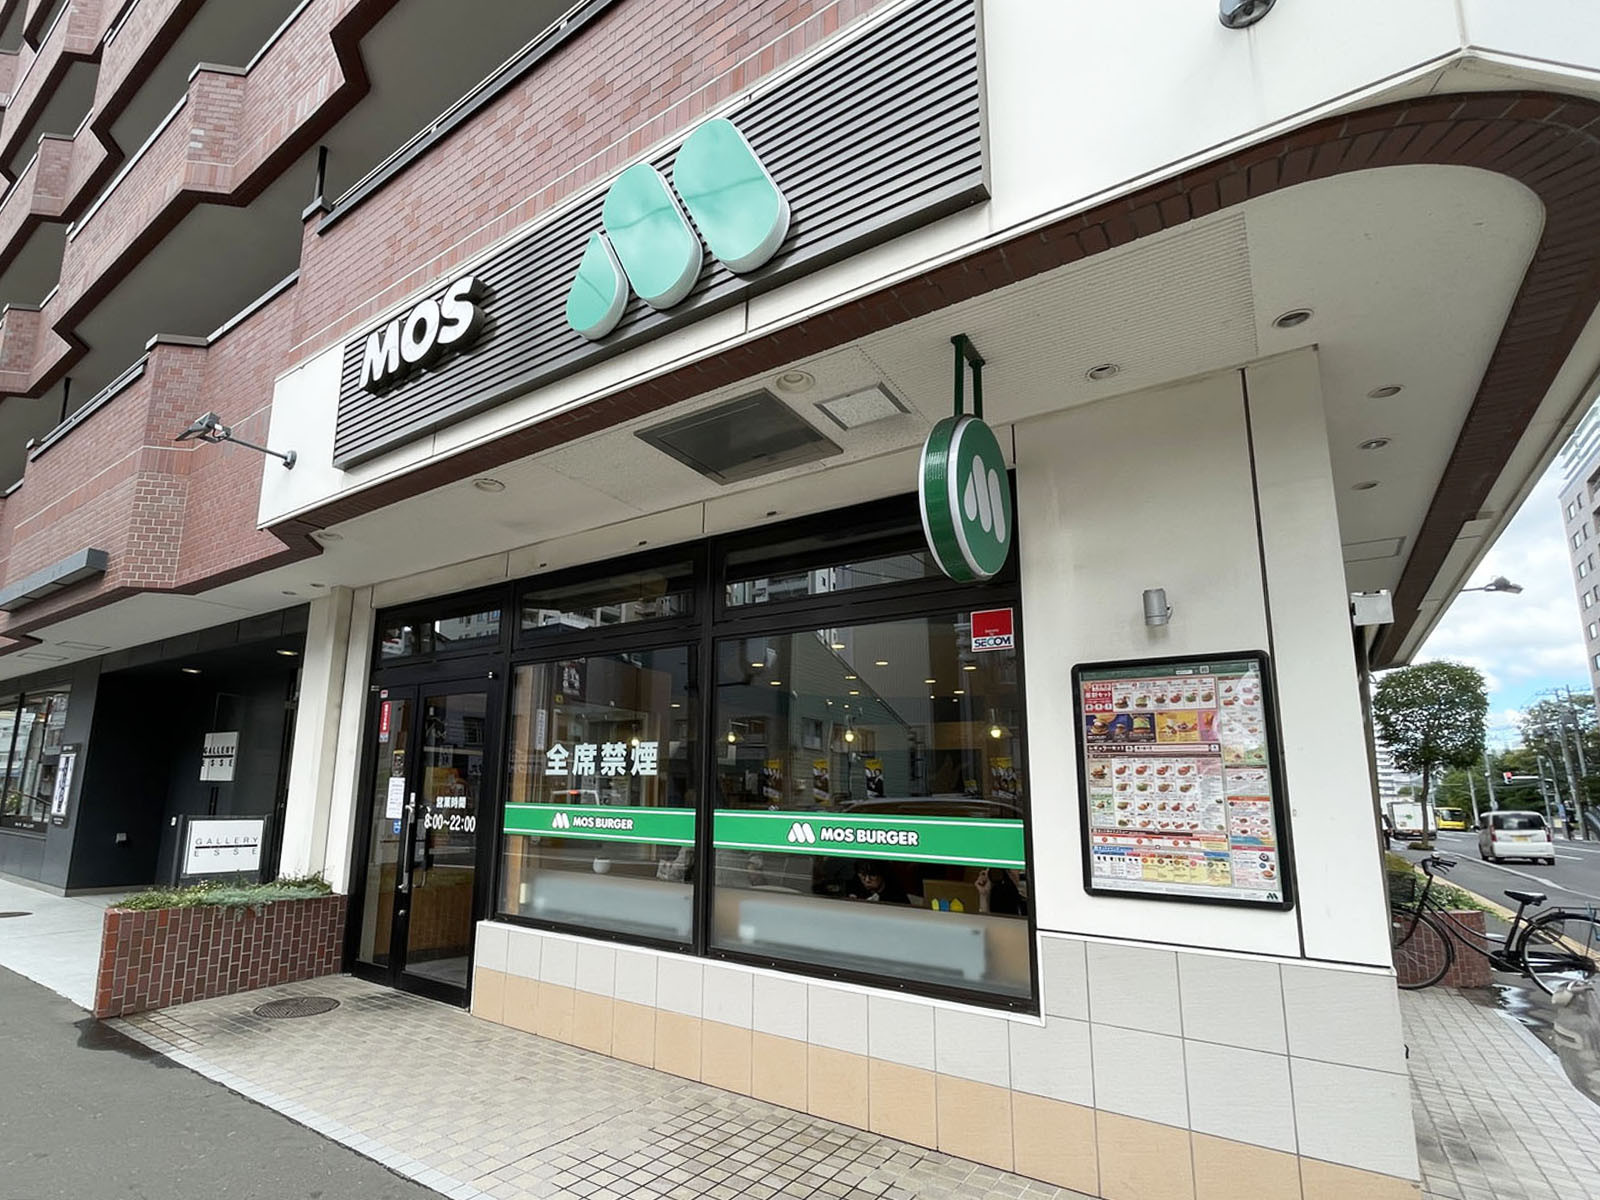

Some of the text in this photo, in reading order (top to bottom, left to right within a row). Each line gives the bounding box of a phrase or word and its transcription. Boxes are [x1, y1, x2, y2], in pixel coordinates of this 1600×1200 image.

[358, 275, 477, 390] MOS
[974, 636, 1012, 648] SECOM
[203, 745, 235, 755] GALLERY
[545, 741, 659, 777] 全席禁煙
[572, 815, 634, 830] MOS BURGER
[195, 836, 259, 845] GALLERY
[819, 826, 919, 847] MOS BURGER
[194, 848, 258, 858] ESSE
